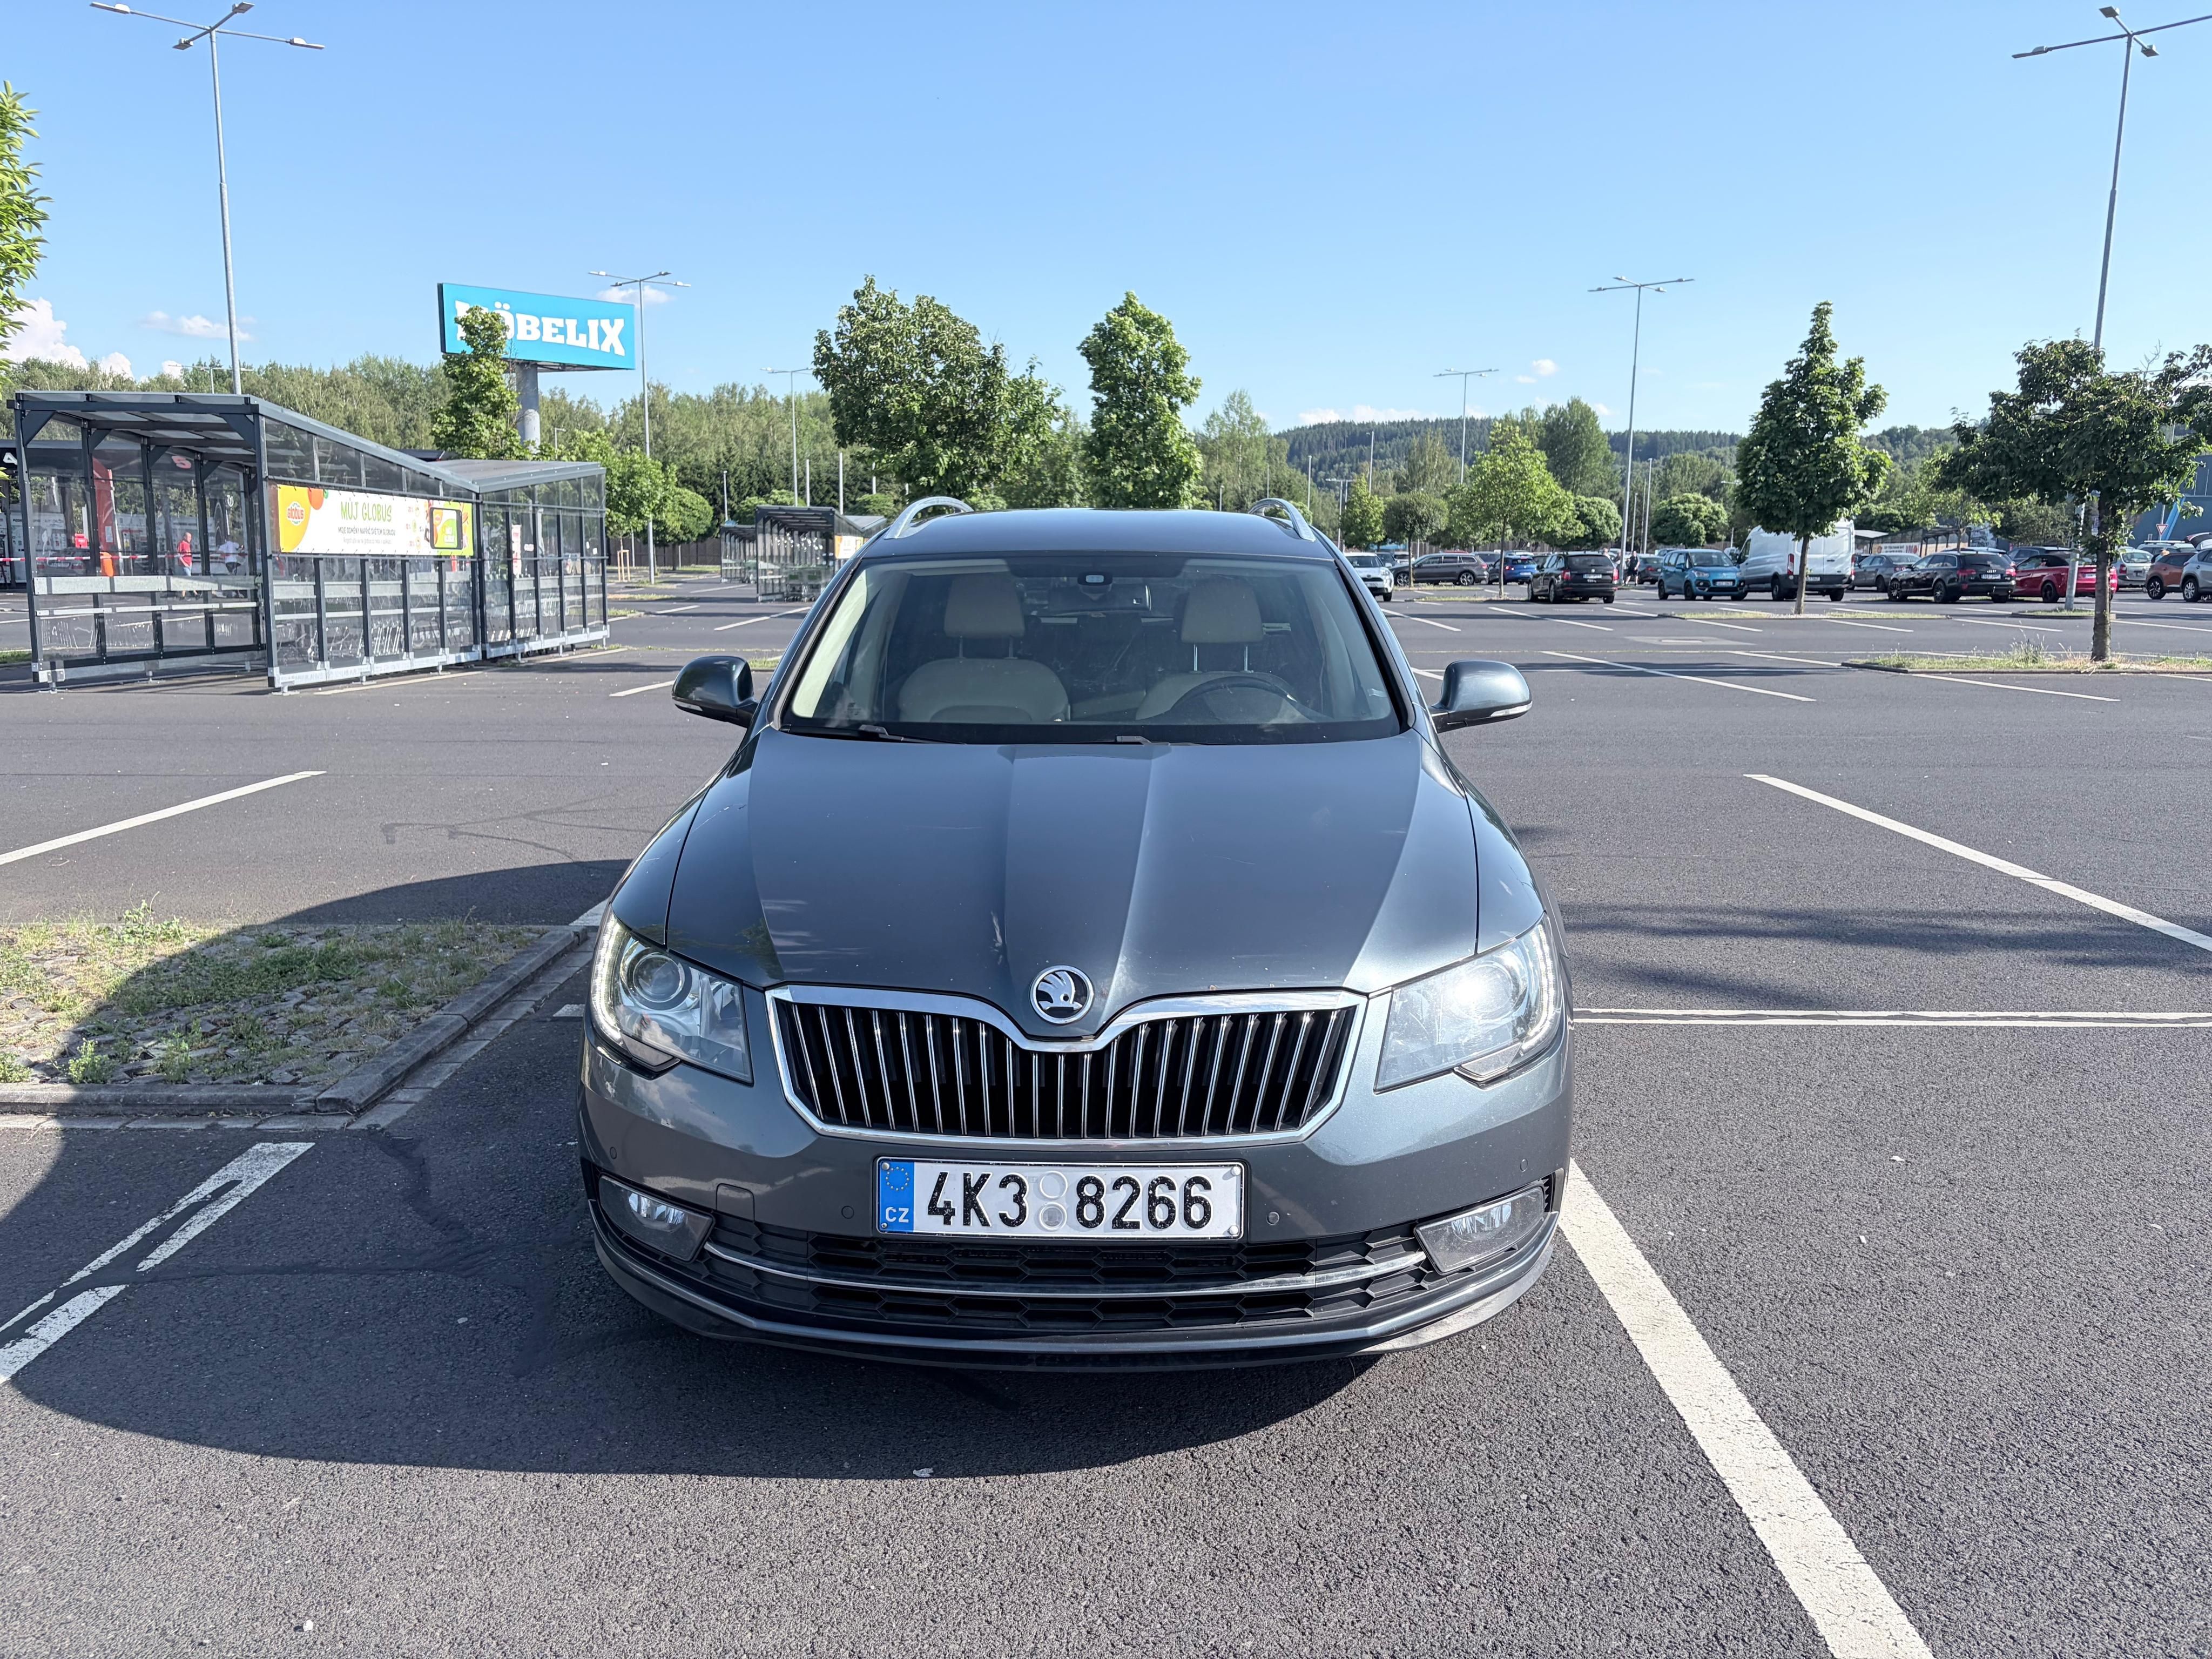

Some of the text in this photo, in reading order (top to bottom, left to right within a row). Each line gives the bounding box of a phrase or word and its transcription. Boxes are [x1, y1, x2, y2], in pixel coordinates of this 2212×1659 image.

[362, 502, 392, 522] GLOBUS
[927, 1171, 1212, 1230] 4K3 8266
[885, 1206, 909, 1223] CZ
